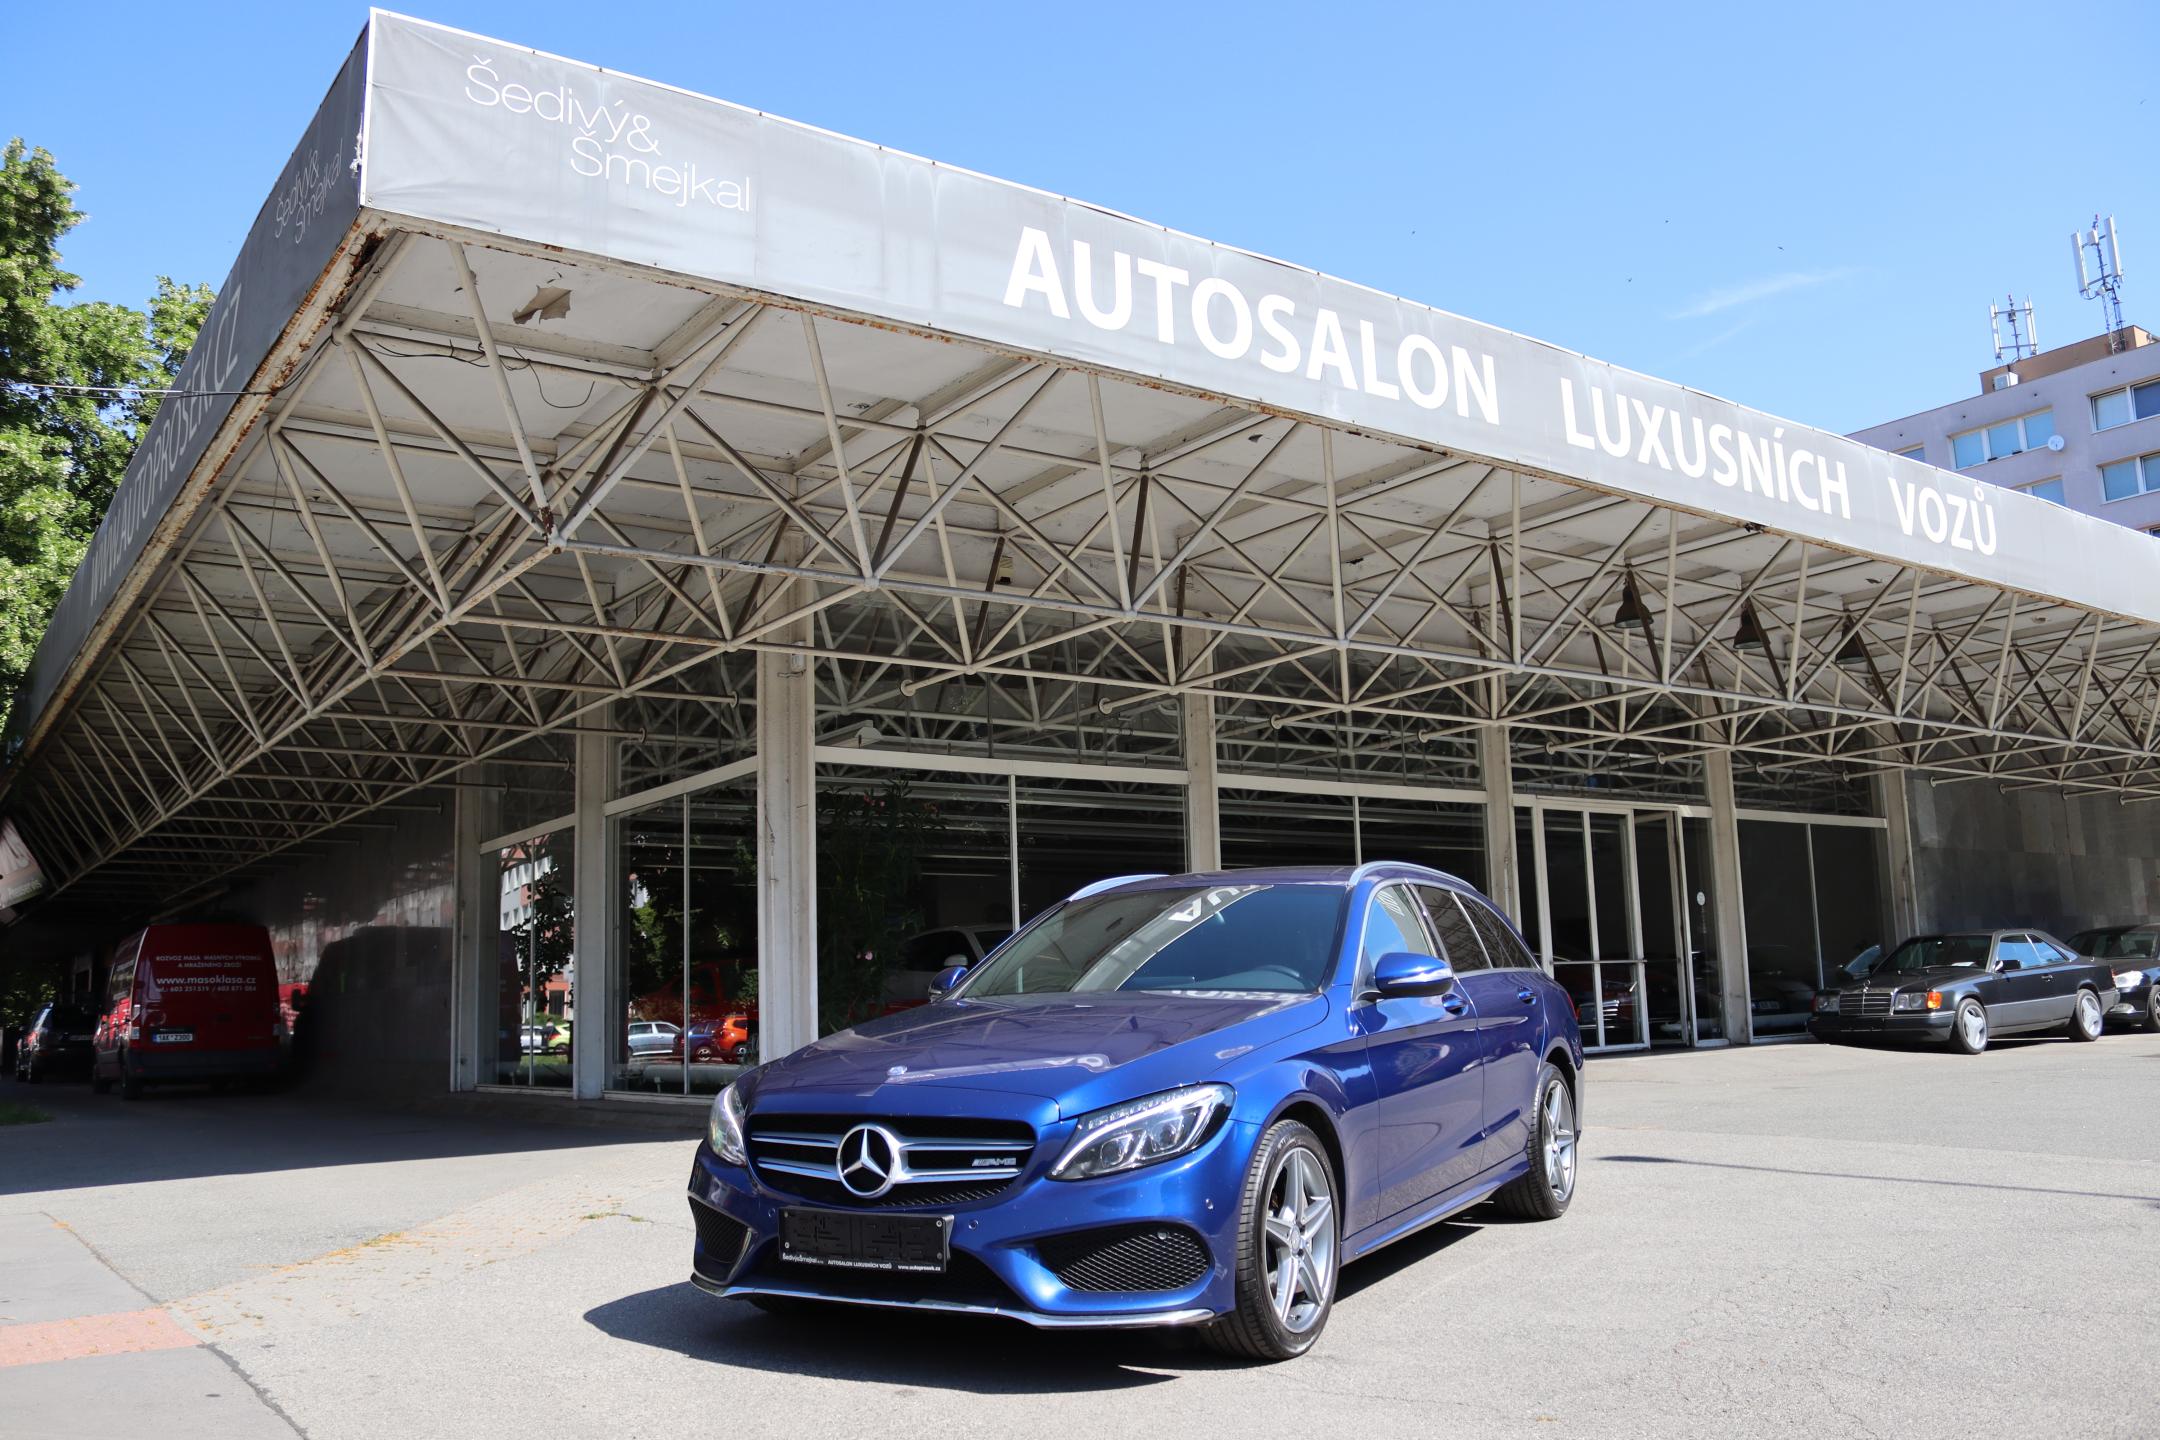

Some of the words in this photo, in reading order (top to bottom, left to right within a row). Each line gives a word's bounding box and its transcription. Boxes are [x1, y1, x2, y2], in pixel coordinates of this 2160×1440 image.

[465, 54, 662, 156] Šedivý&
[295, 138, 343, 244] Šmejkal
[570, 126, 751, 212] Šmejkal
[1003, 226, 1500, 426] AUTOSALON
[1560, 377, 1851, 520] LUXUSNÍCH
[1888, 476, 1998, 556] VOZŮ
[155, 974, 257, 985] www.masoklasa.cz
[827, 1259, 853, 1267] AUTOSALON
